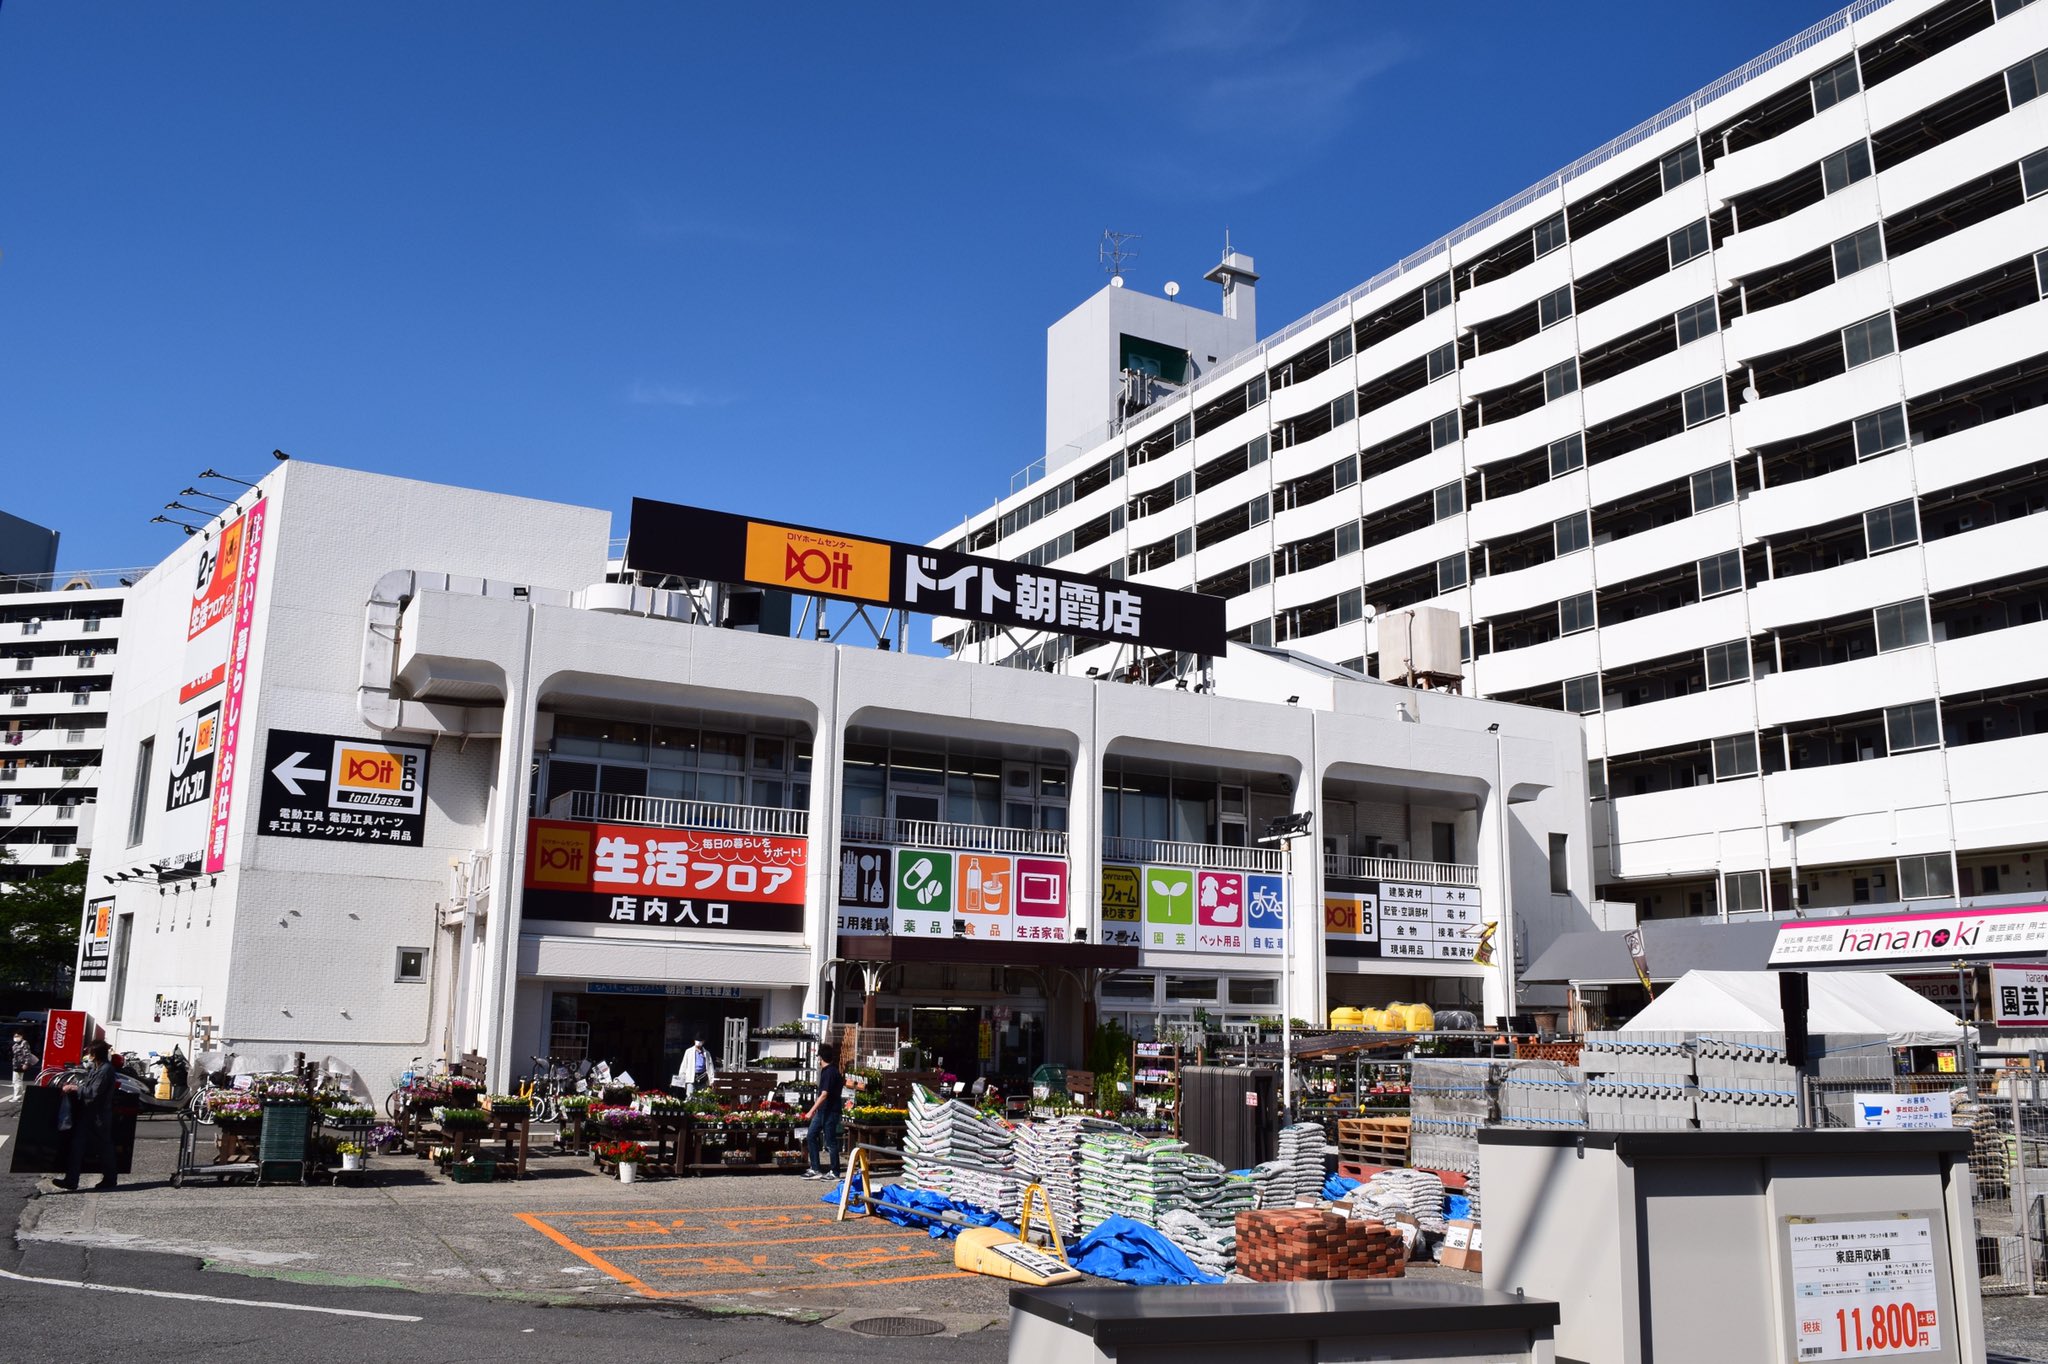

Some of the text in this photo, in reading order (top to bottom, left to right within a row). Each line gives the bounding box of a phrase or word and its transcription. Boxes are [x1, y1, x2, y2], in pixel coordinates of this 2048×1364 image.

[787, 532, 853, 549] DIYホームセンター
[196, 550, 217, 590] 2F
[904, 554, 1142, 637] ドイト朝霞店
[190, 594, 225, 636] 生活フロア
[177, 726, 191, 766] 1F
[401, 754, 418, 792] PRO
[171, 770, 206, 808] ドイトプロ
[279, 807, 404, 828] 電動工具 電動工具パーツ
[269, 820, 412, 841] 手工具 ワークツール カー用品
[702, 838, 771, 850] 毎日の暮らしを
[593, 837, 792, 895] 生活フロア
[1388, 887, 1466, 901] 建築資材 木材
[609, 896, 729, 925] 店内入口
[1362, 900, 1373, 935] PRO
[1384, 905, 1467, 920] 配管・空調部材 電材
[837, 915, 890, 932] 日用雑貨
[903, 919, 942, 934] 薬品
[964, 922, 1001, 937] 食品
[1397, 925, 1418, 937] 金物
[2028, 921, 2047, 930] 用土
[1016, 925, 1065, 941] 生活家電
[1153, 932, 1186, 946] 園芸
[1200, 934, 1241, 948] ペット用品
[1839, 920, 1985, 953] hananoki
[1253, 936, 1283, 949] 自転車
[1390, 944, 1424, 956] 現場用品
[1442, 946, 1474, 957] 農業資材
[1836, 1248, 1891, 1264] 家庭用収納庫
[1803, 1321, 1821, 1333] 税抜
[1836, 1302, 1918, 1352] 11,800
[1918, 1332, 1929, 1347] 円
